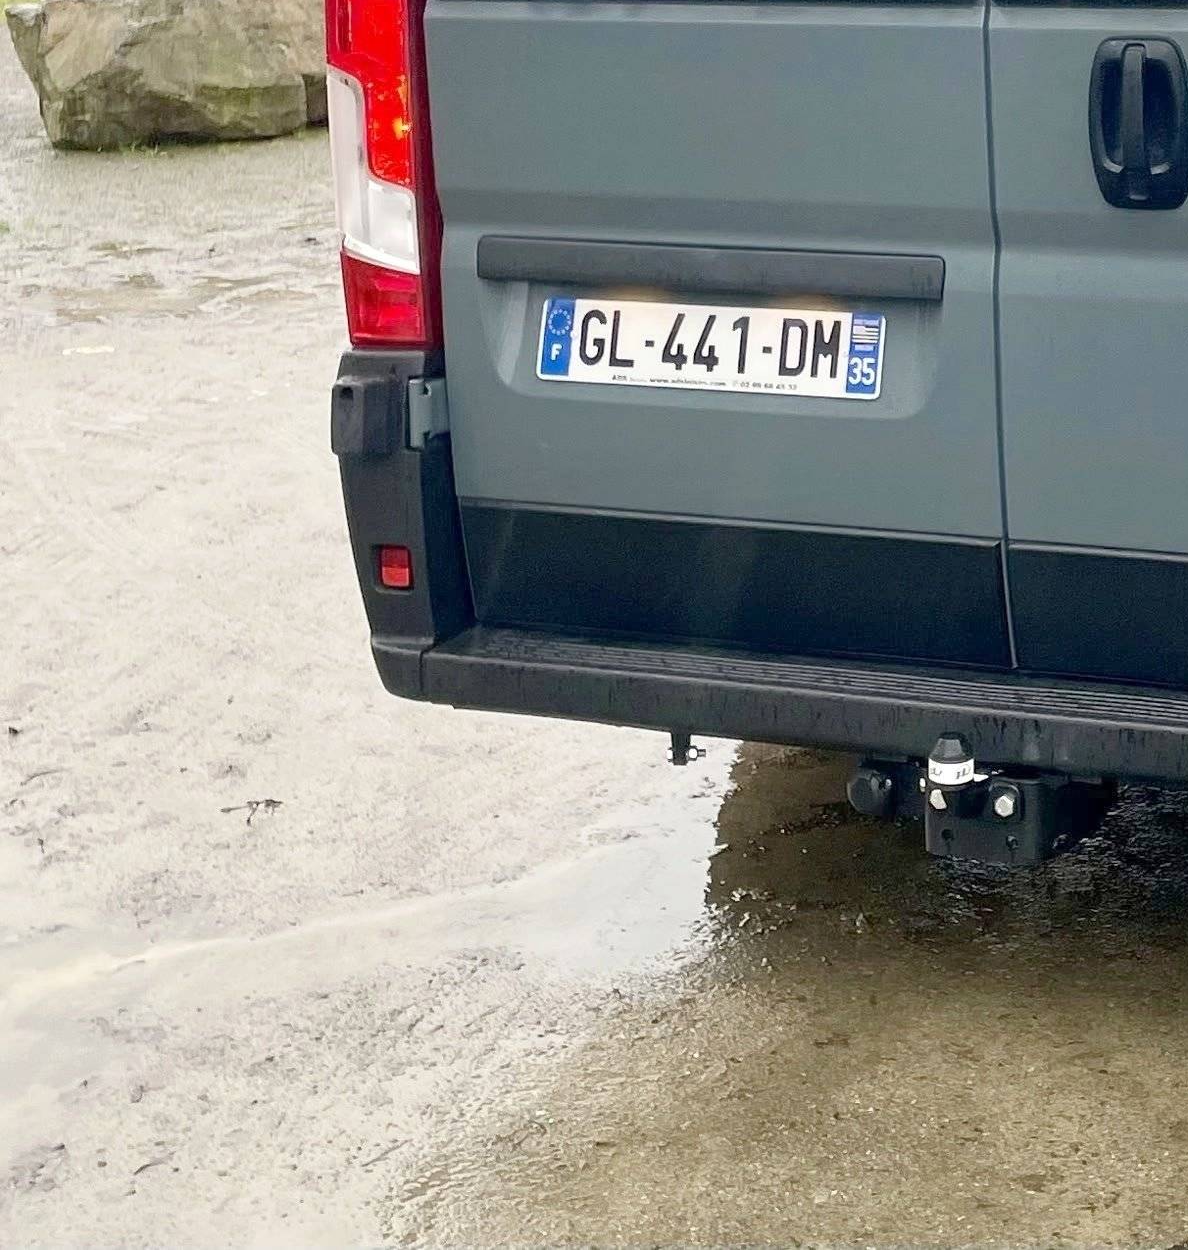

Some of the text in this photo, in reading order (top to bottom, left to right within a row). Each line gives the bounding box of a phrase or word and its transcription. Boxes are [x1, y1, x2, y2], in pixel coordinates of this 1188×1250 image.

[550, 343, 562, 362] F
[578, 308, 842, 379] GL-441-DM
[848, 356, 876, 387] 35
